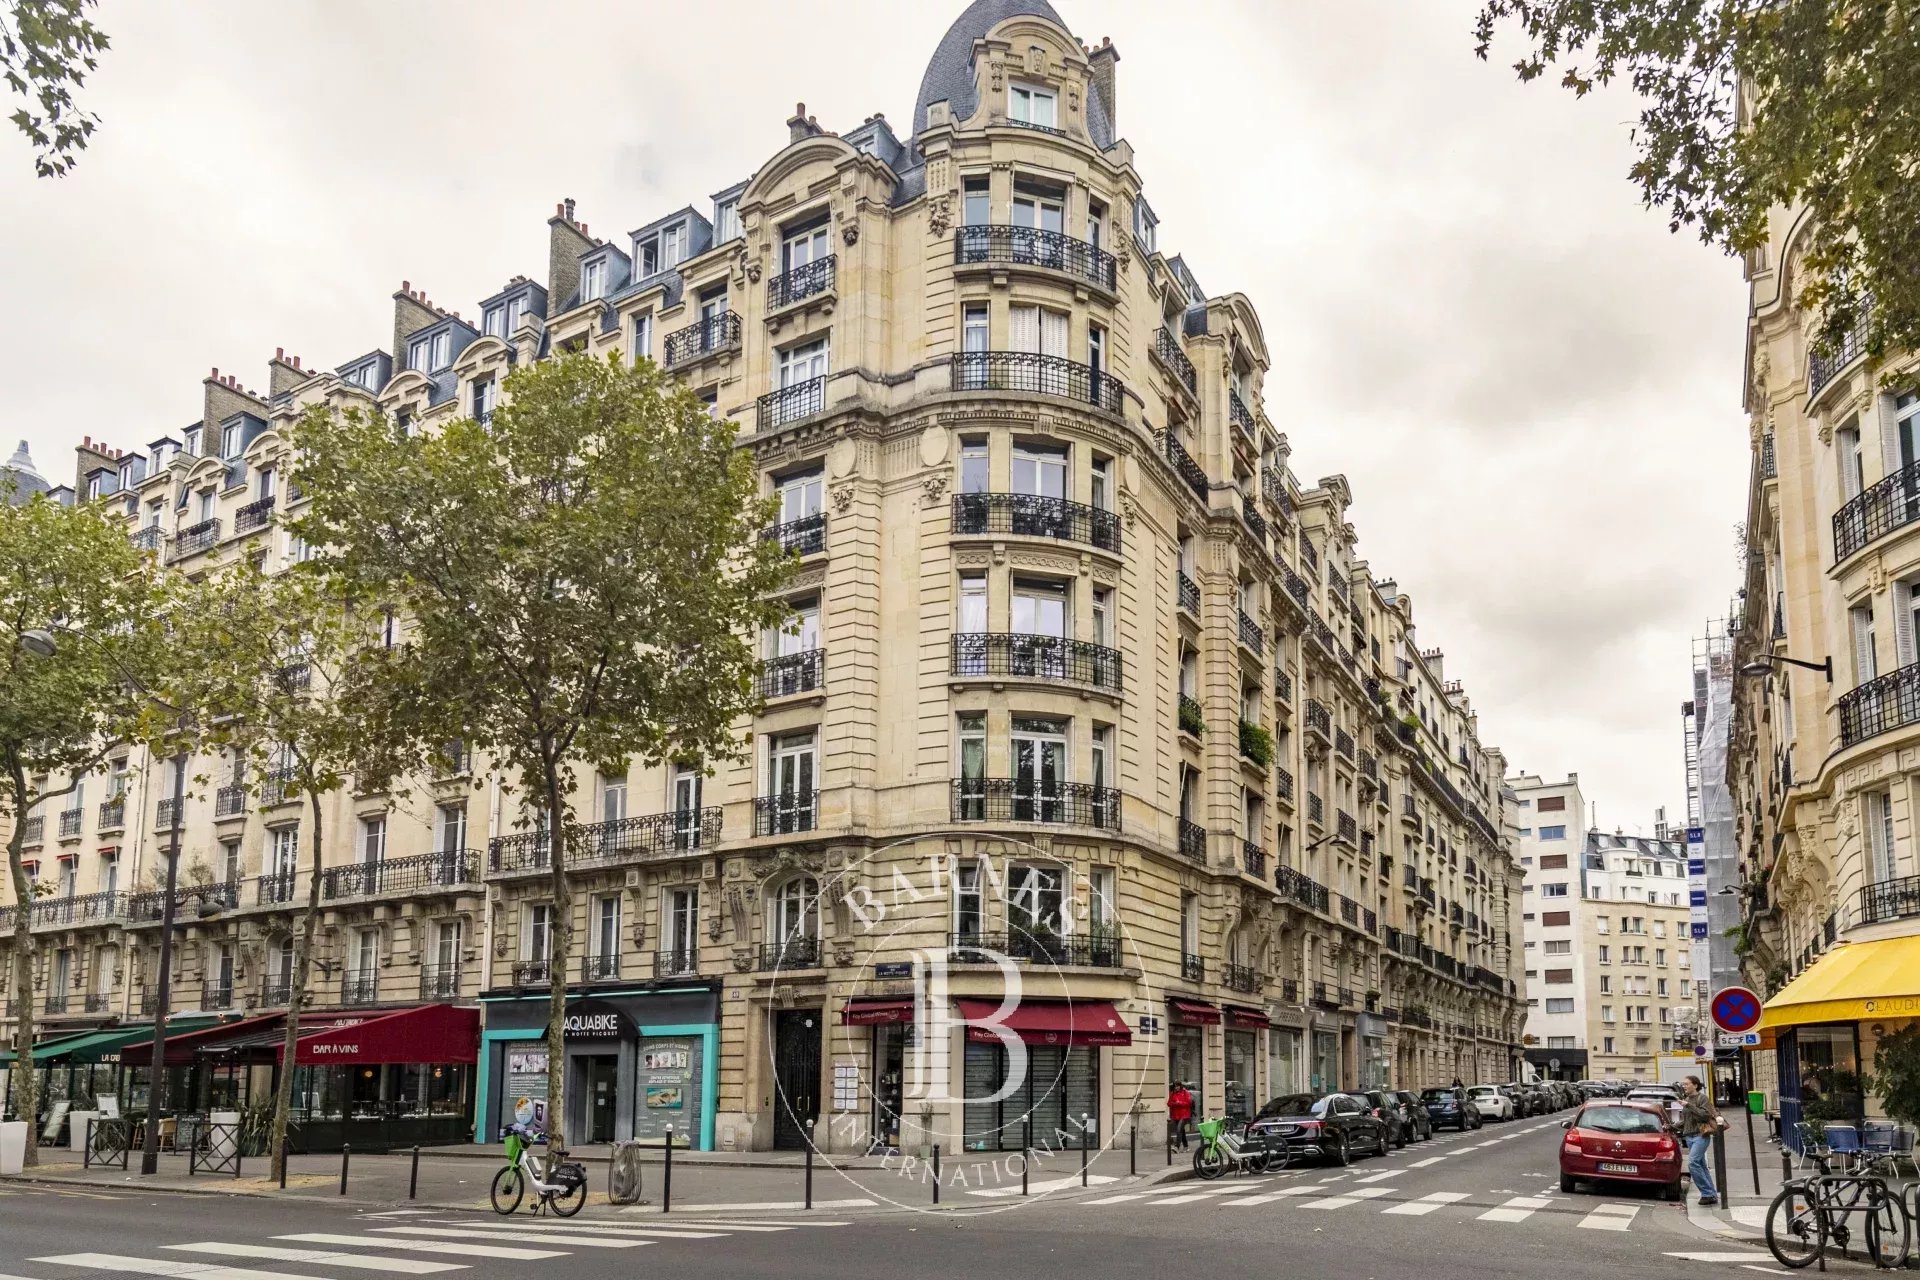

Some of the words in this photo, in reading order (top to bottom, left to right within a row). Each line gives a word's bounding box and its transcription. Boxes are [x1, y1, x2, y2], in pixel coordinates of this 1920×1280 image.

[563, 1014, 618, 1031] AQUABIKE
[313, 1044, 332, 1054] BAR
[338, 1044, 359, 1053] VINS
[101, 1054, 109, 1062] LA
